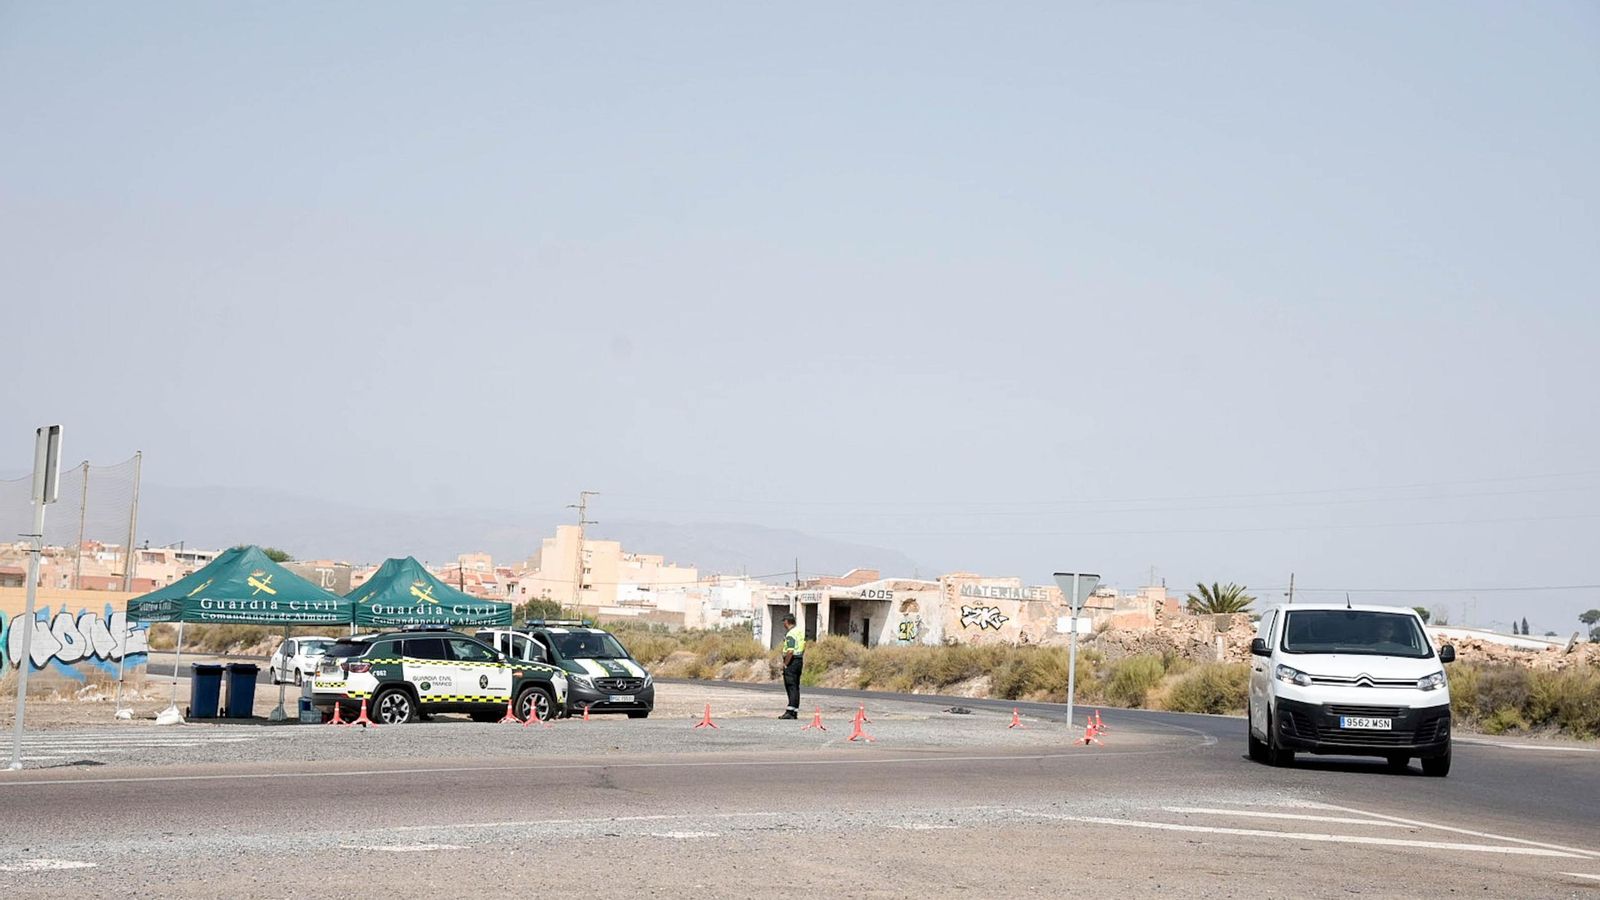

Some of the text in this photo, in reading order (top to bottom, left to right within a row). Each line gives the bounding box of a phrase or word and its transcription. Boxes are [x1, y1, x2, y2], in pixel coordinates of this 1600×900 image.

[860, 589, 894, 601] ADOS
[960, 583, 1048, 600] MATERIALES
[200, 597, 338, 611] Guardia Civil
[371, 602, 498, 616] Guardia Civil
[200, 611, 279, 621] Comandancia
[279, 612, 291, 621] de
[372, 616, 441, 626] Comandancia
[443, 616, 455, 626] de
[1346, 717, 1391, 729] 9562 MSN
